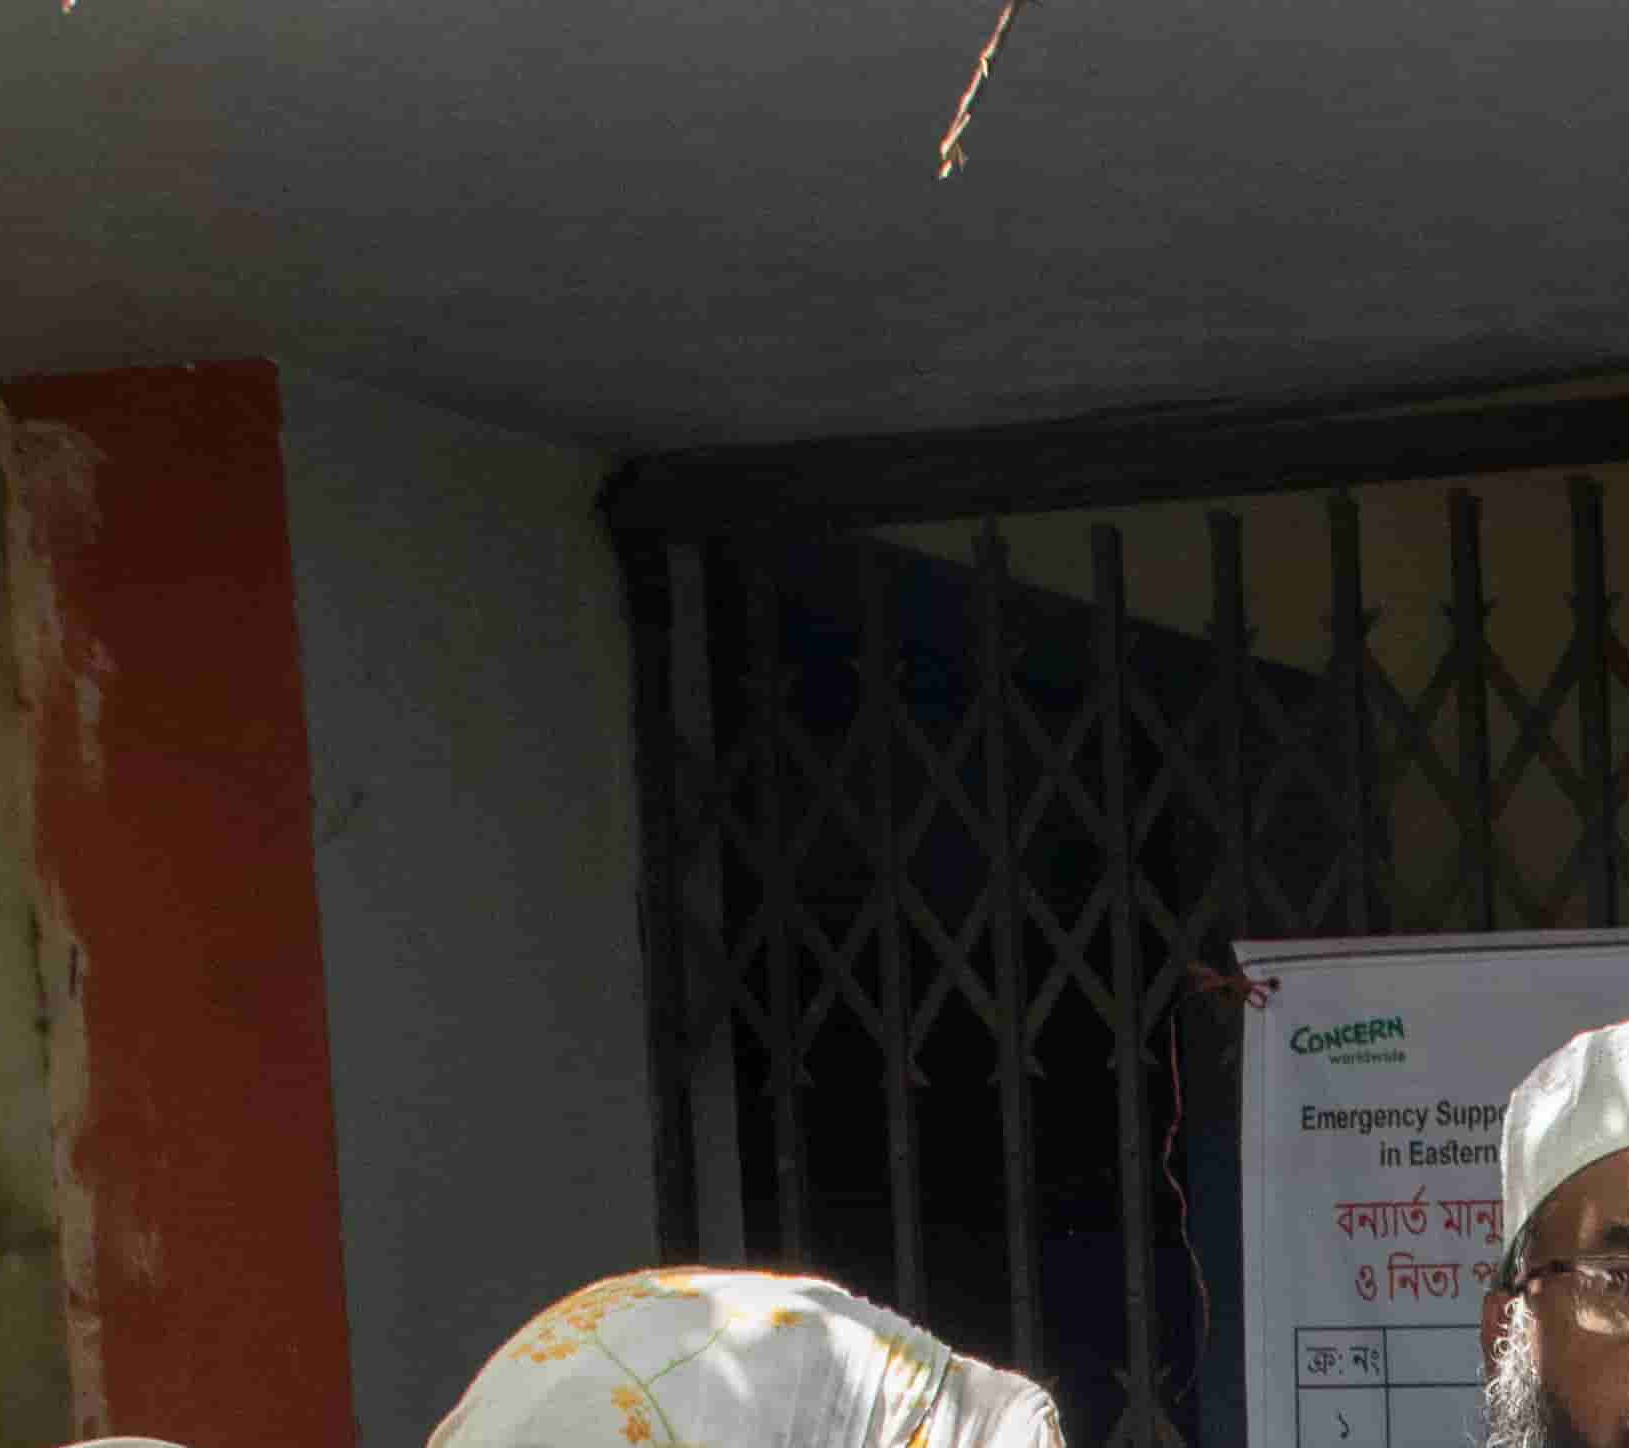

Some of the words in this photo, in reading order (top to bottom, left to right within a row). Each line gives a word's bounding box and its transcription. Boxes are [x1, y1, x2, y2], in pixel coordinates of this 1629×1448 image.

[1290, 1016, 1406, 1055] CONCERN
[1328, 1050, 1407, 1065] worldwide
[1301, 1104, 1429, 1136] Emergency
[1379, 1140, 1401, 1167] in
[1409, 1138, 1499, 1167] Eastern
[1334, 1184, 1429, 1239] বন্যার্ত
[1437, 1199, 1505, 1245] মানু
[1355, 1264, 1378, 1301] ও
[1387, 1251, 1462, 1302] নিত্য
[1336, 1411, 1351, 1440] ১
